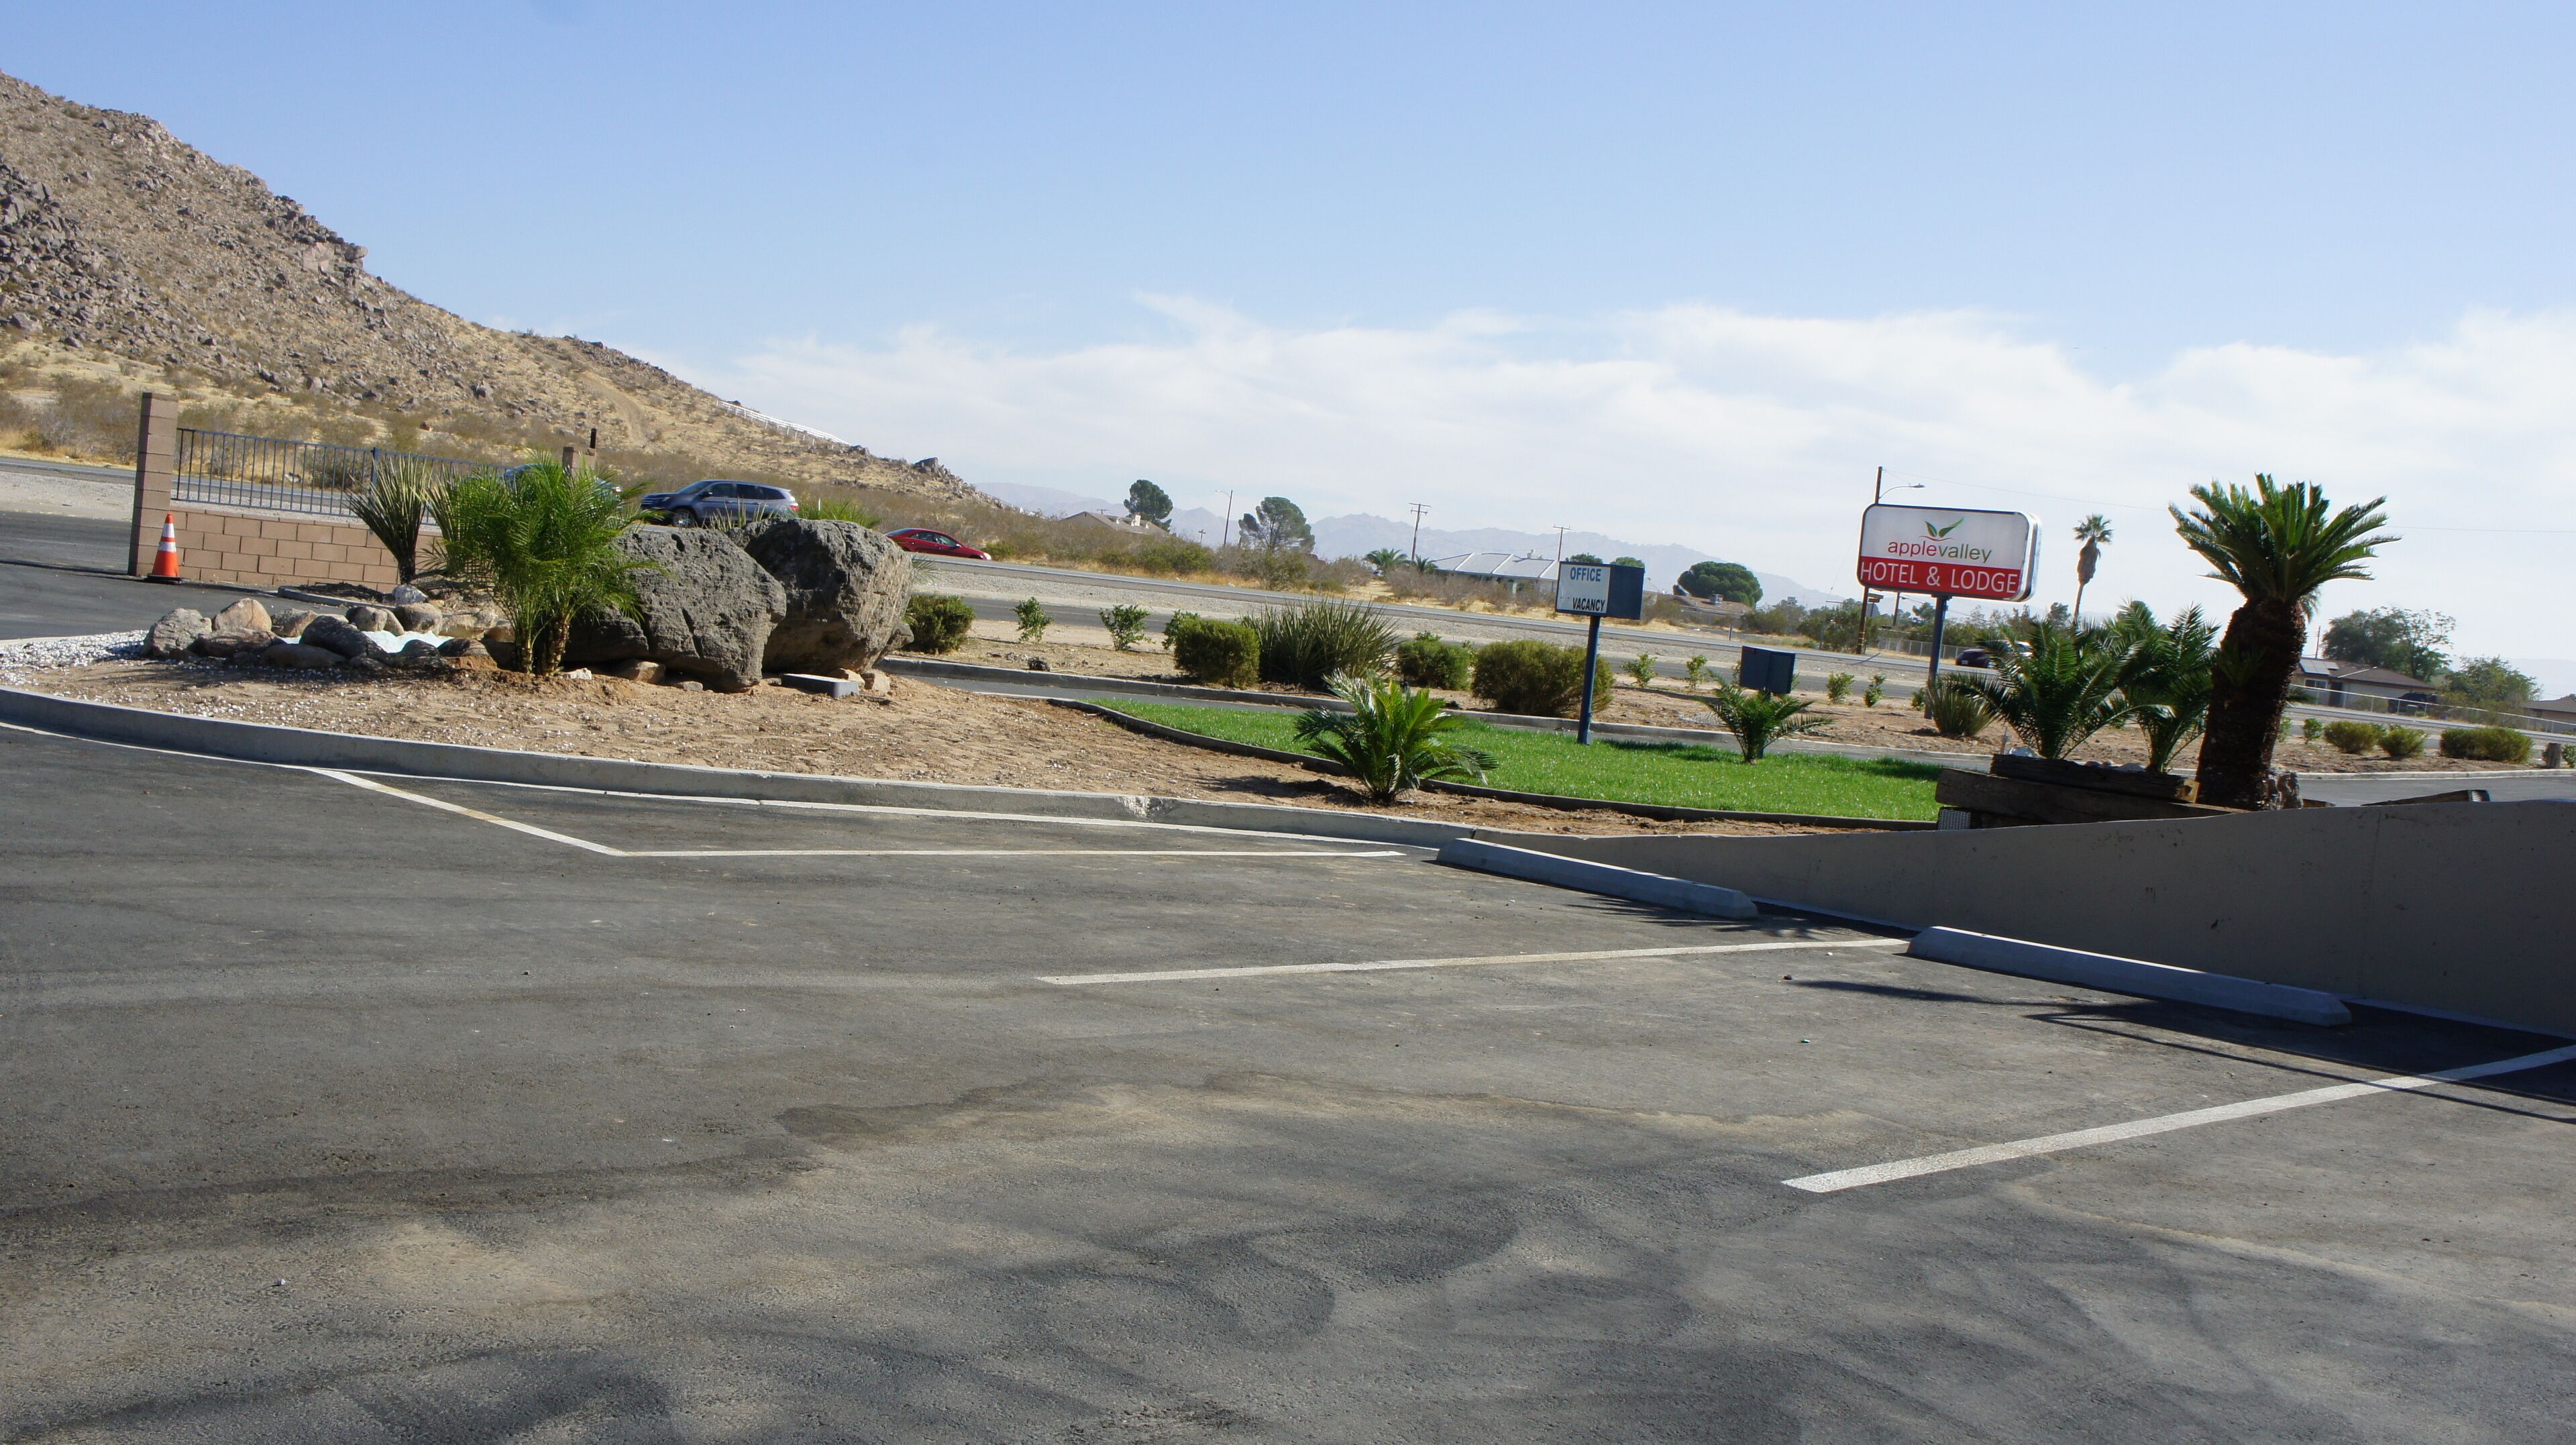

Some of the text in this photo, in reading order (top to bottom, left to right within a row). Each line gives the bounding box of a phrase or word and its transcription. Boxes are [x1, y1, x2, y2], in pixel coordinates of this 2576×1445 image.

[1888, 541, 1992, 563] applevalley
[1570, 568, 1601, 582] OFFICE
[1860, 561, 2018, 593] HOTEL & LODGE
[1573, 598, 1605, 612] VACANCY
